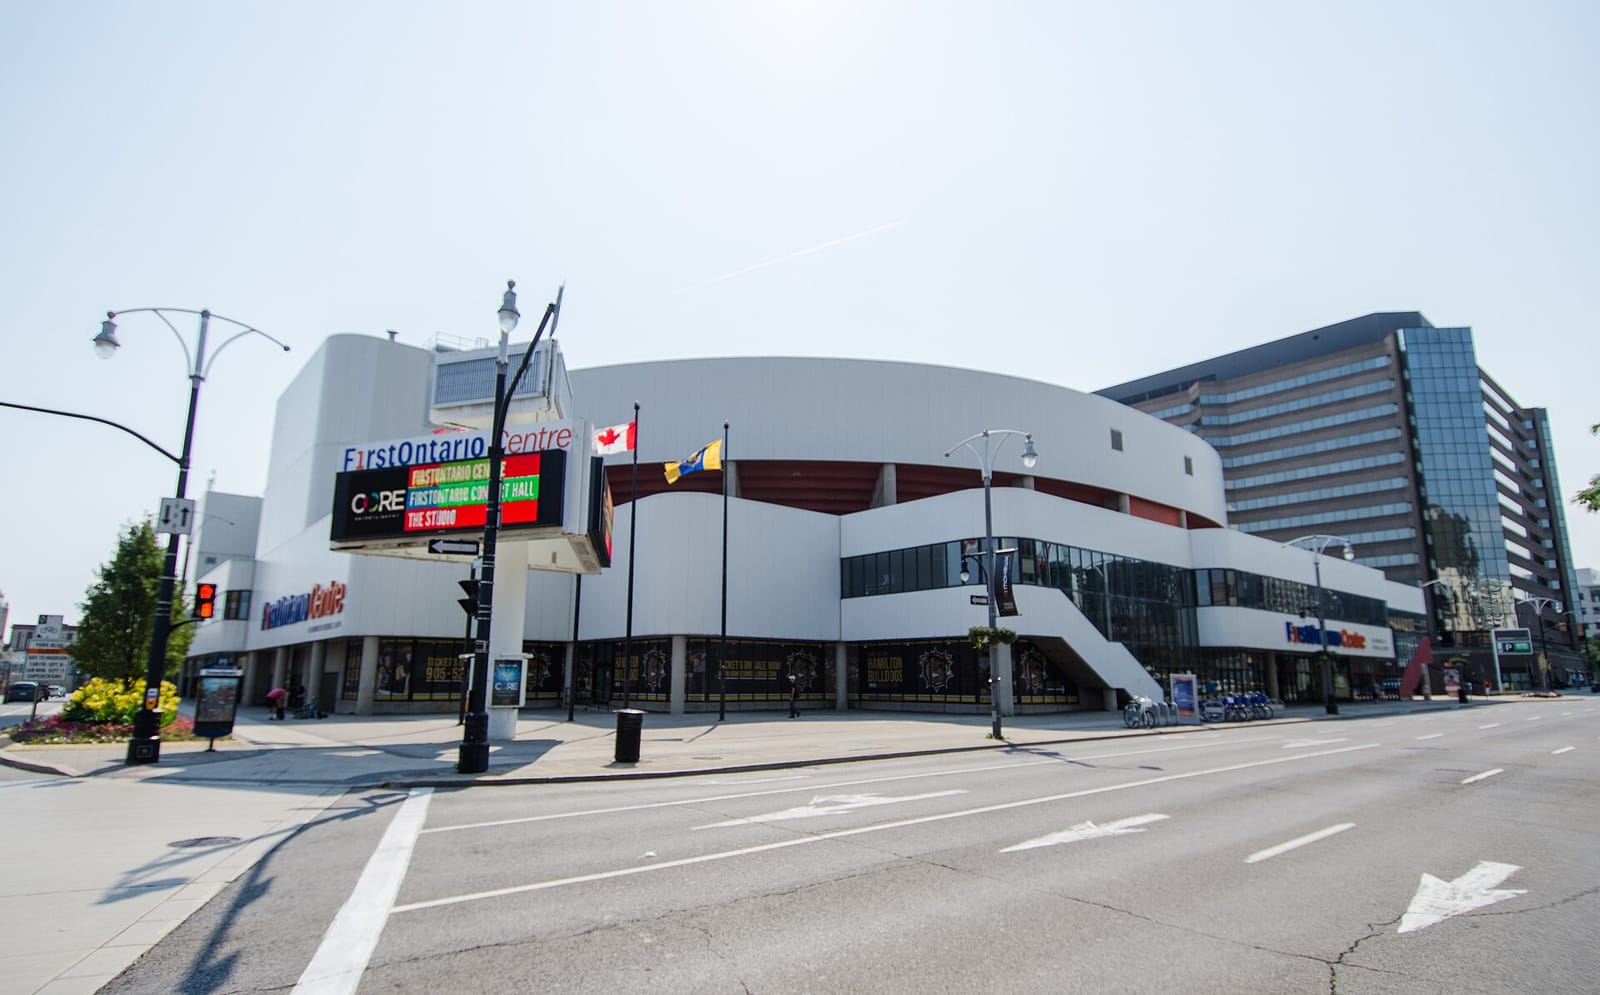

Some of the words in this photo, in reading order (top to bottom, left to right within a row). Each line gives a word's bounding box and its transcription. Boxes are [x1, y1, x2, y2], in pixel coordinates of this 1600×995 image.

[411, 464, 472, 486] FIRSTONTARIO
[472, 460, 507, 481] CENE
[351, 489, 406, 514] CORE
[409, 486, 469, 507] FIRSTONTARIO
[470, 482, 509, 502] CONT
[511, 480, 534, 498] HALL
[407, 511, 424, 528] THE
[425, 509, 457, 526] STUDIO
[867, 656, 903, 669] HAMILTON
[426, 667, 465, 680] 905-52
[867, 669, 903, 682] BULLDOGS
